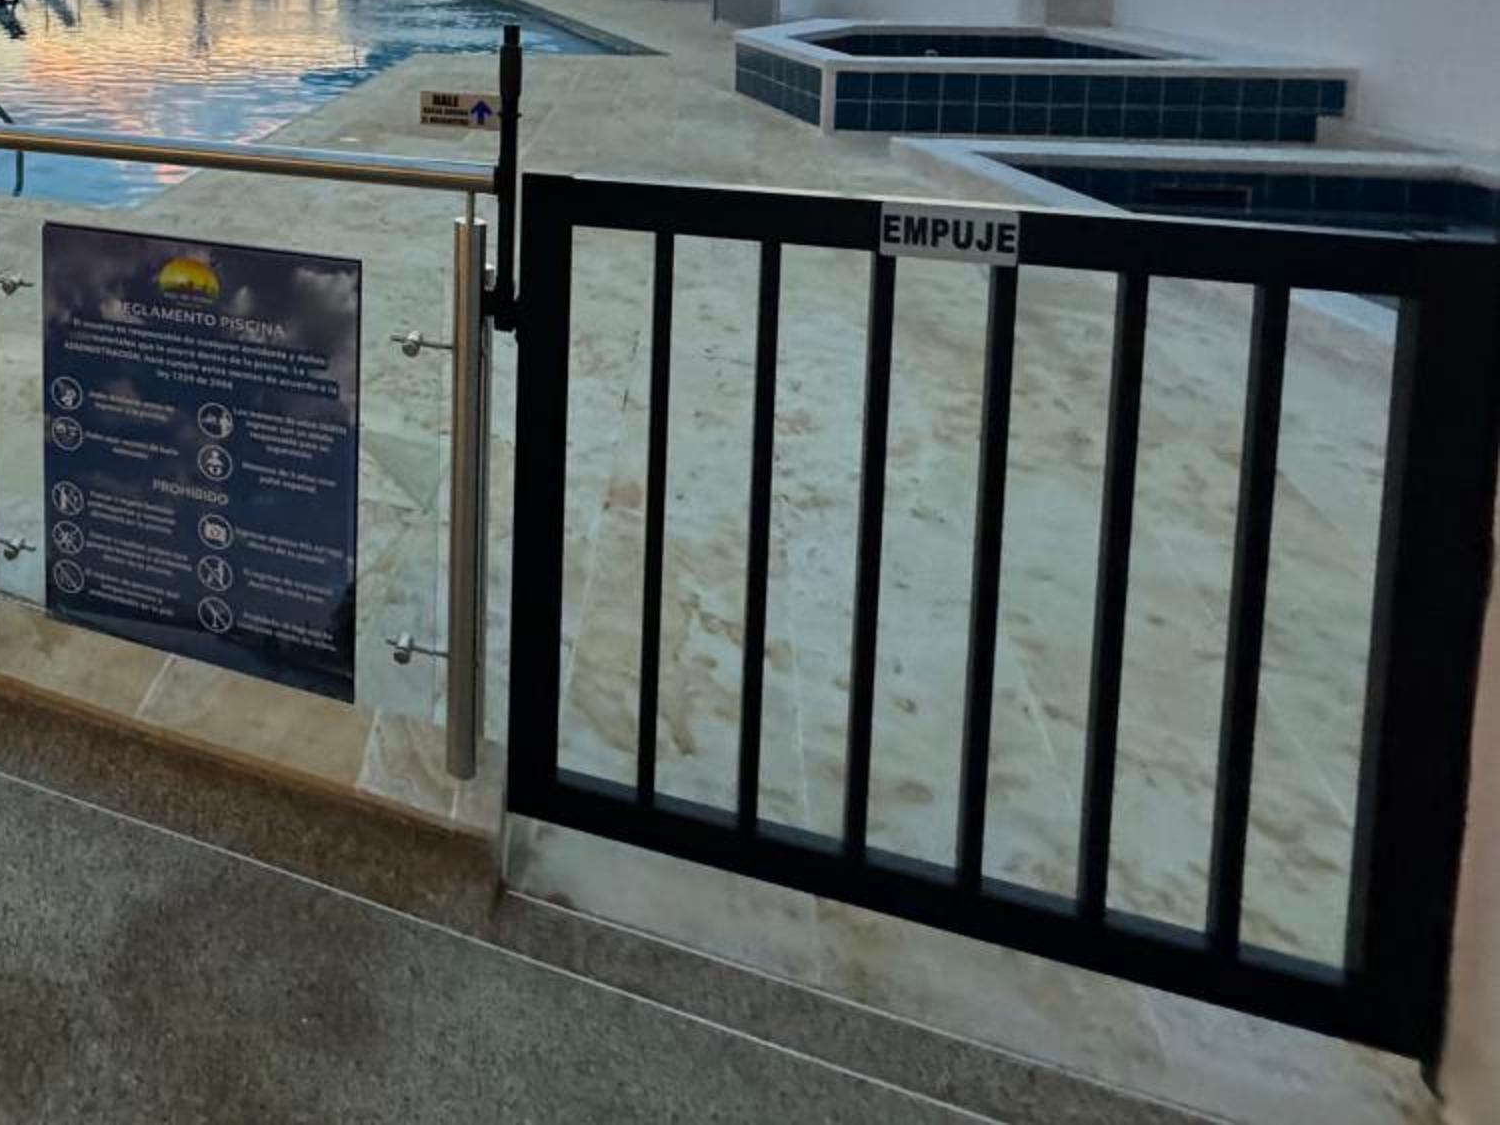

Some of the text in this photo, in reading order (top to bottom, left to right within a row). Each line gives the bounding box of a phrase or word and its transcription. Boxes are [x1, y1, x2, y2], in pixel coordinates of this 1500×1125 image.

[883, 214, 1016, 254] EMPUJE
[114, 299, 218, 327] REGLAMENTO
[220, 315, 287, 338] PISCINA
[152, 477, 229, 506] PROHIBIDO
